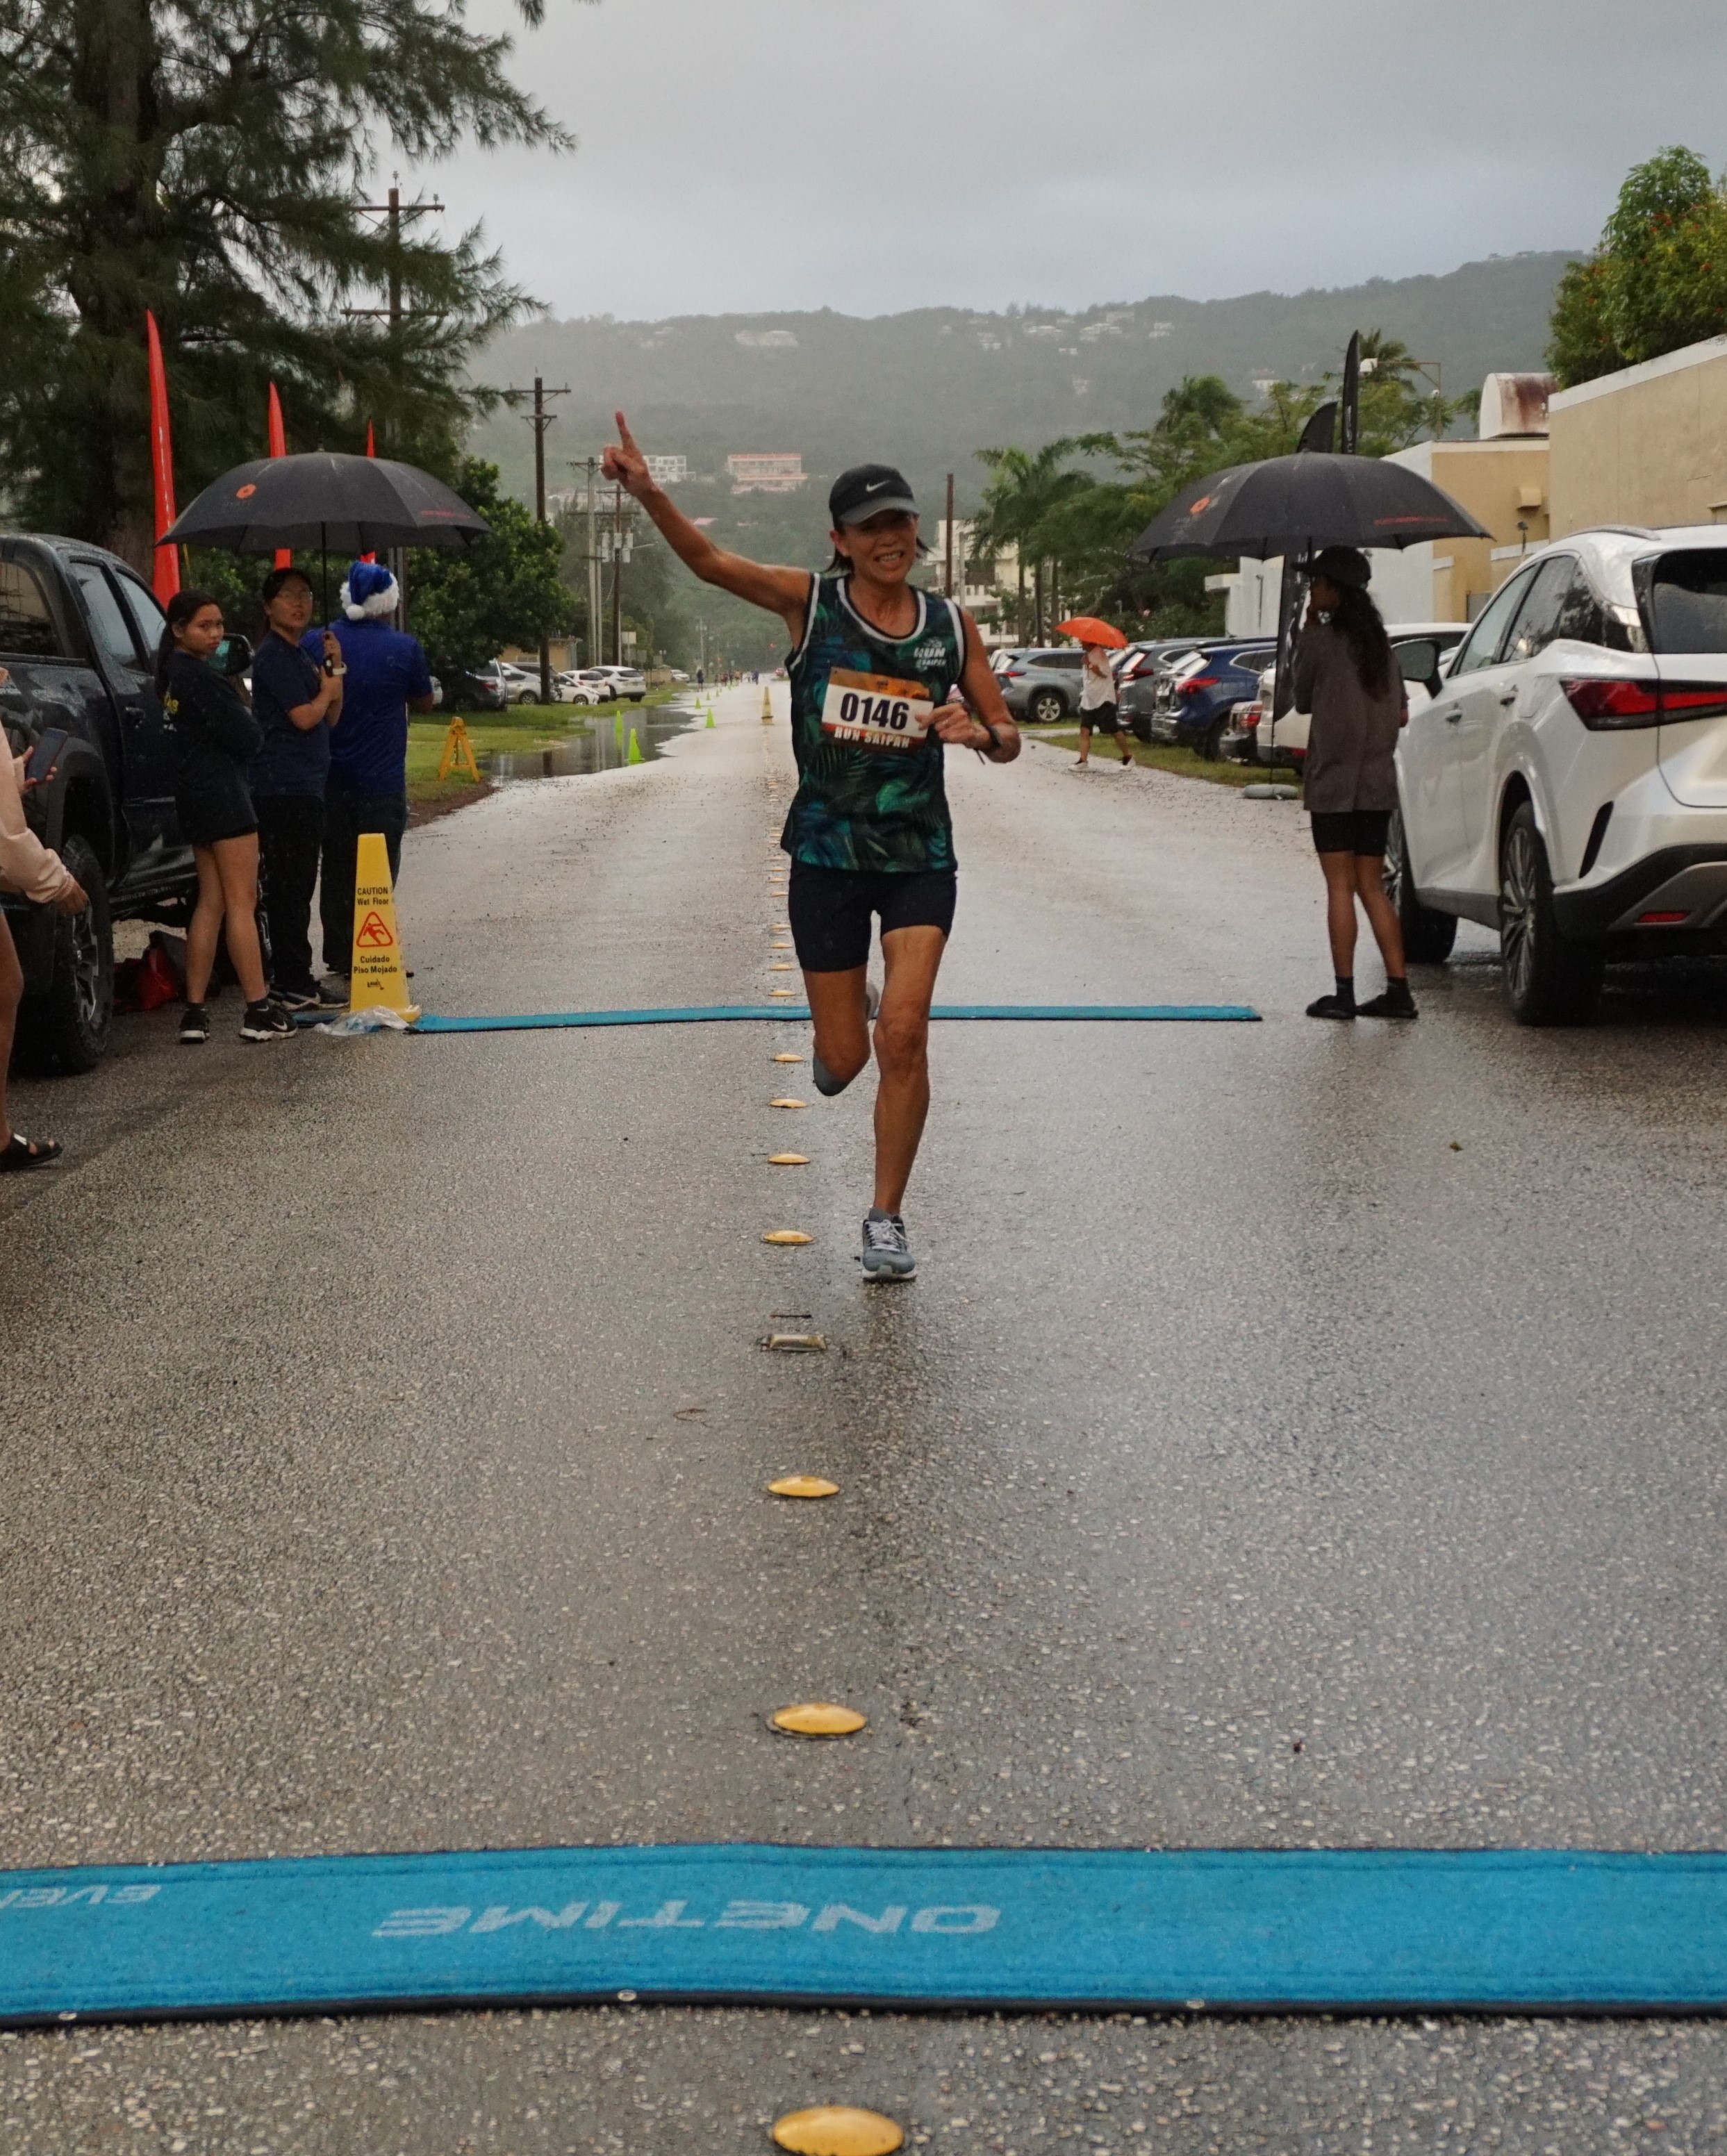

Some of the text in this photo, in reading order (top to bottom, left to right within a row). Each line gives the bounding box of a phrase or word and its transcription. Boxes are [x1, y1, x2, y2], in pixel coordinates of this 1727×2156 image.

[914, 647, 946, 658] RUN
[840, 692, 909, 730] 0146
[834, 727, 909, 747] RUN SAIPAN
[357, 887, 388, 895] CAUTION
[357, 897, 370, 906] Wet
[370, 965, 397, 975] Mojado
[374, 1900, 1001, 1937] ONETIME
